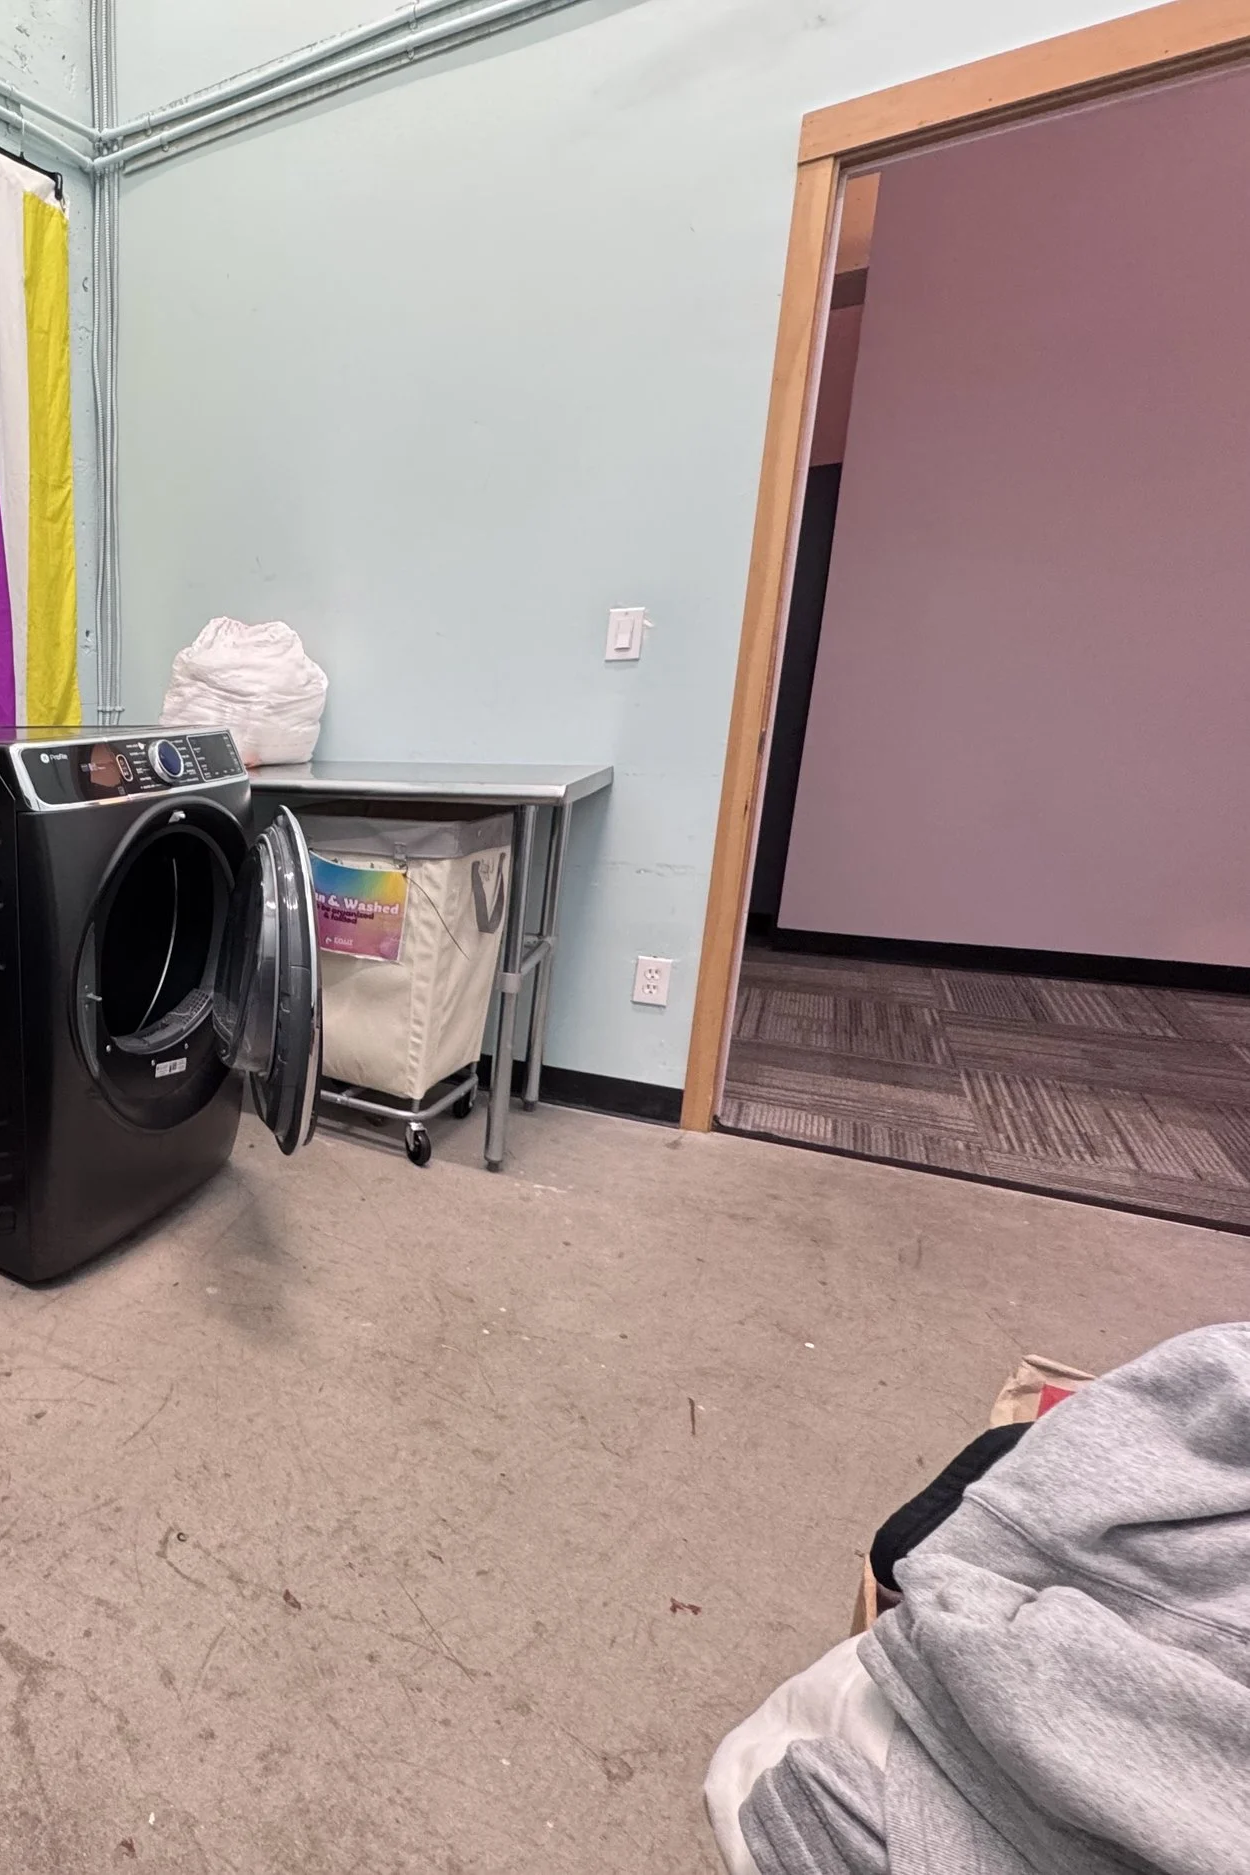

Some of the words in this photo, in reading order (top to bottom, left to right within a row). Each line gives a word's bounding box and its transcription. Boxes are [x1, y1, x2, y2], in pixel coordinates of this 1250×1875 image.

[328, 895, 340, 907] &
[344, 898, 399, 914] Washed
[332, 908, 374, 920] organized
